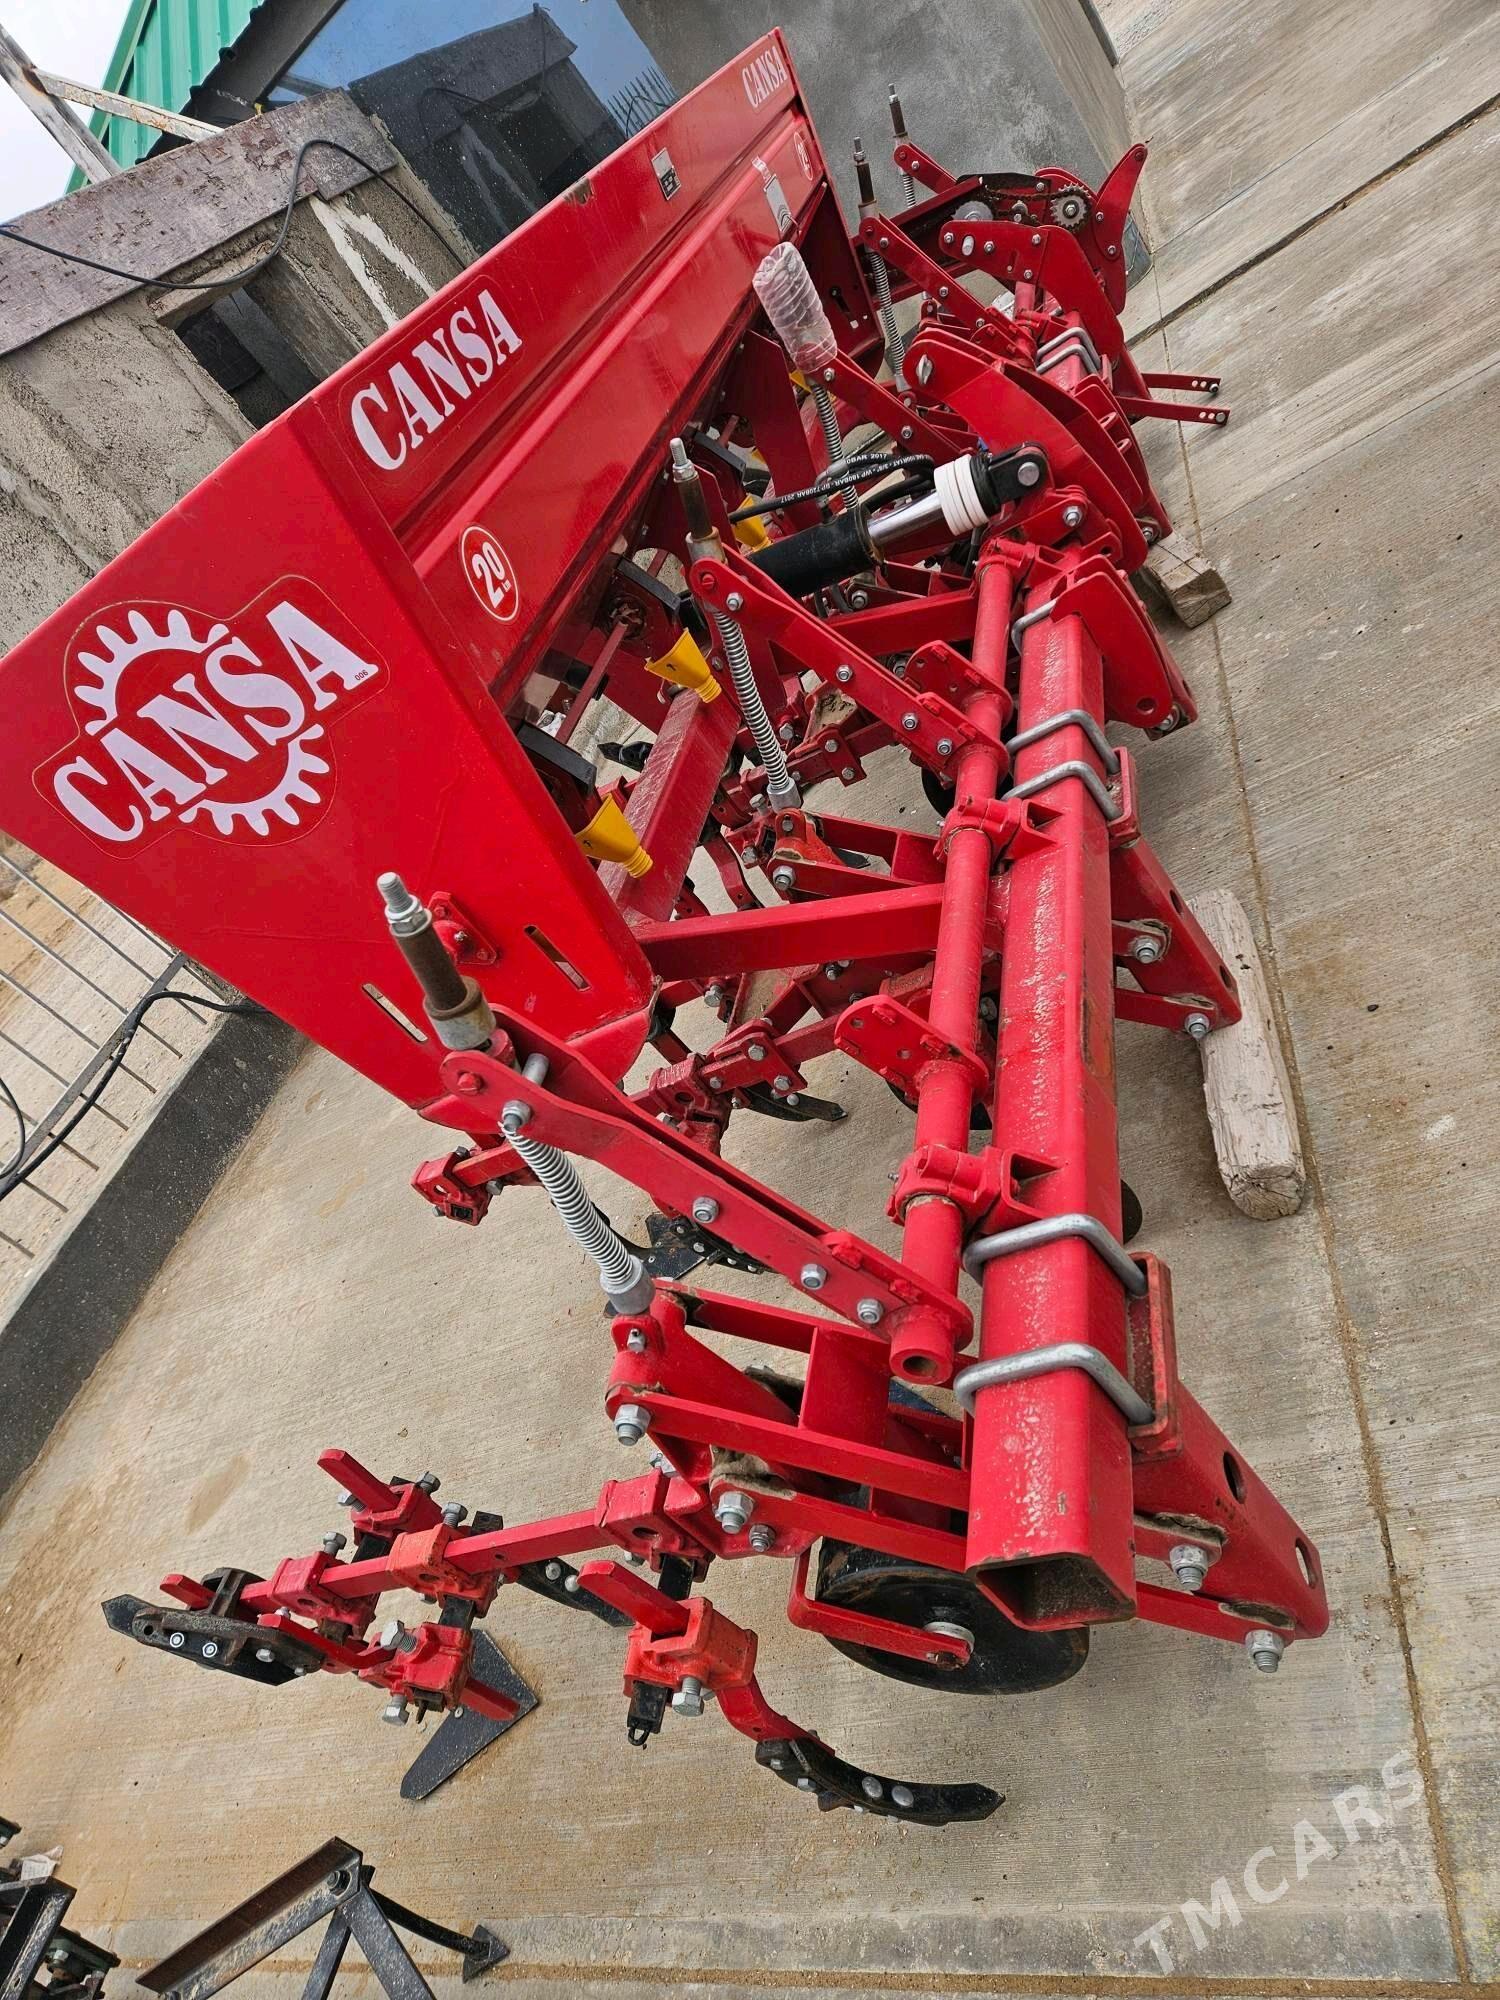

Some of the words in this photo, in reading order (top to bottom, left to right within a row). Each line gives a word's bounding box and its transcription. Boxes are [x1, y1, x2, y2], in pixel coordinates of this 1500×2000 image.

[742, 46, 788, 108] CANSA
[351, 289, 523, 470] CANSA
[53, 600, 379, 842] CANSA
